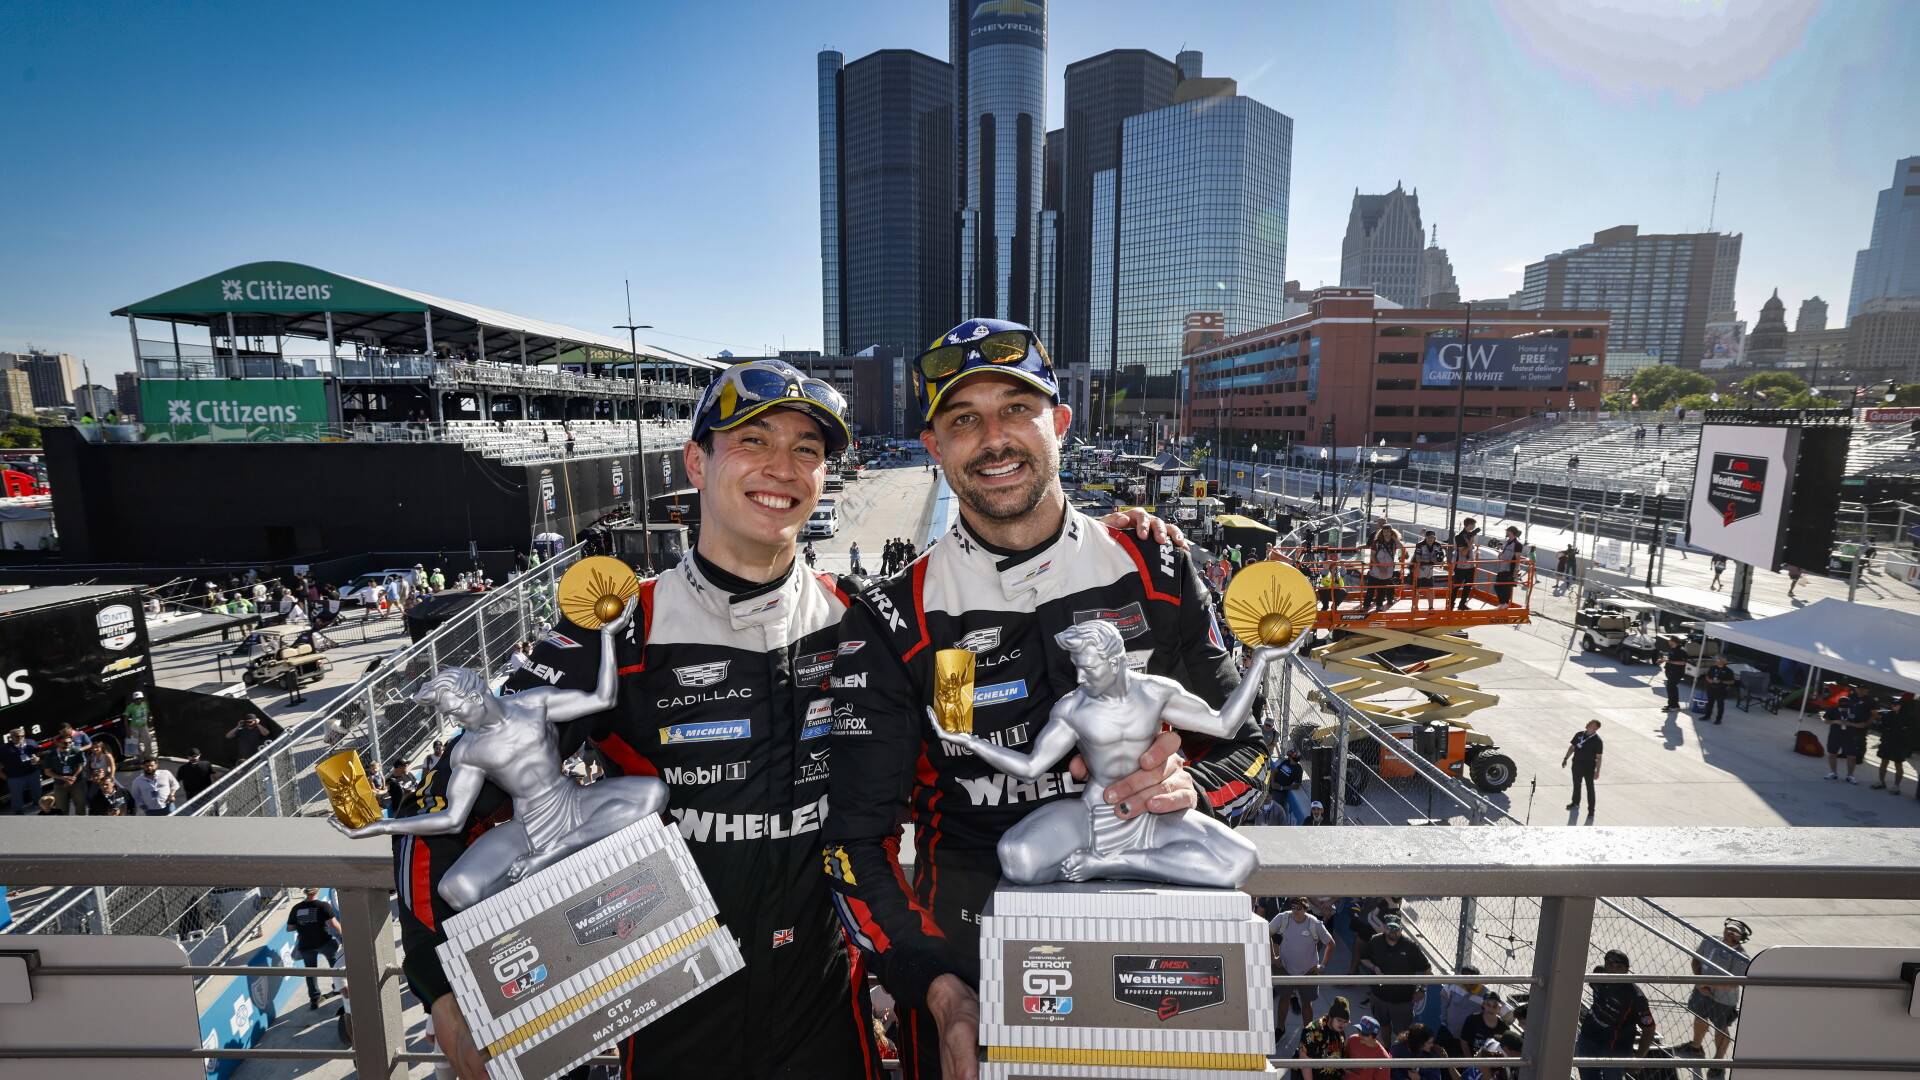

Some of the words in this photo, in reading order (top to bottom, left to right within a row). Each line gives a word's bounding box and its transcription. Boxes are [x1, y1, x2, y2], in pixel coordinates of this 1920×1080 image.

[971, 23, 1042, 37] CHEVROLE
[246, 280, 331, 300] Citizens
[1438, 343, 1499, 370] GW
[1520, 354, 1546, 364] FREE
[1511, 364, 1534, 372] fastest
[1535, 364, 1564, 373] delivery
[1429, 371, 1471, 381] GARDNR
[1474, 372, 1504, 381] WHITE
[196, 401, 297, 423] Citizens
[1869, 410, 1920, 421] Grandsta
[1712, 474, 1763, 491] WeatherTech
[1196, 487, 1205, 497] 10
[111, 611, 128, 620] NTT
[866, 586, 909, 633] HRX
[99, 621, 135, 635] INDYCAR
[797, 663, 834, 676] Weather
[656, 688, 752, 708] CADILLAC
[685, 725, 743, 737] MICHELIN
[664, 764, 722, 786] Mobil
[488, 937, 532, 965] DETROIT
[493, 945, 539, 983] GP
[1022, 960, 1072, 969] DETROIT
[1159, 960, 1190, 969] IMSA
[1022, 969, 1073, 995] GP
[1118, 973, 1219, 985] WeatherTech
[607, 998, 632, 1018] GTP
[592, 1023, 615, 1042] MAY
[617, 1012, 633, 1028] 30,
[632, 999, 658, 1018] 2026
